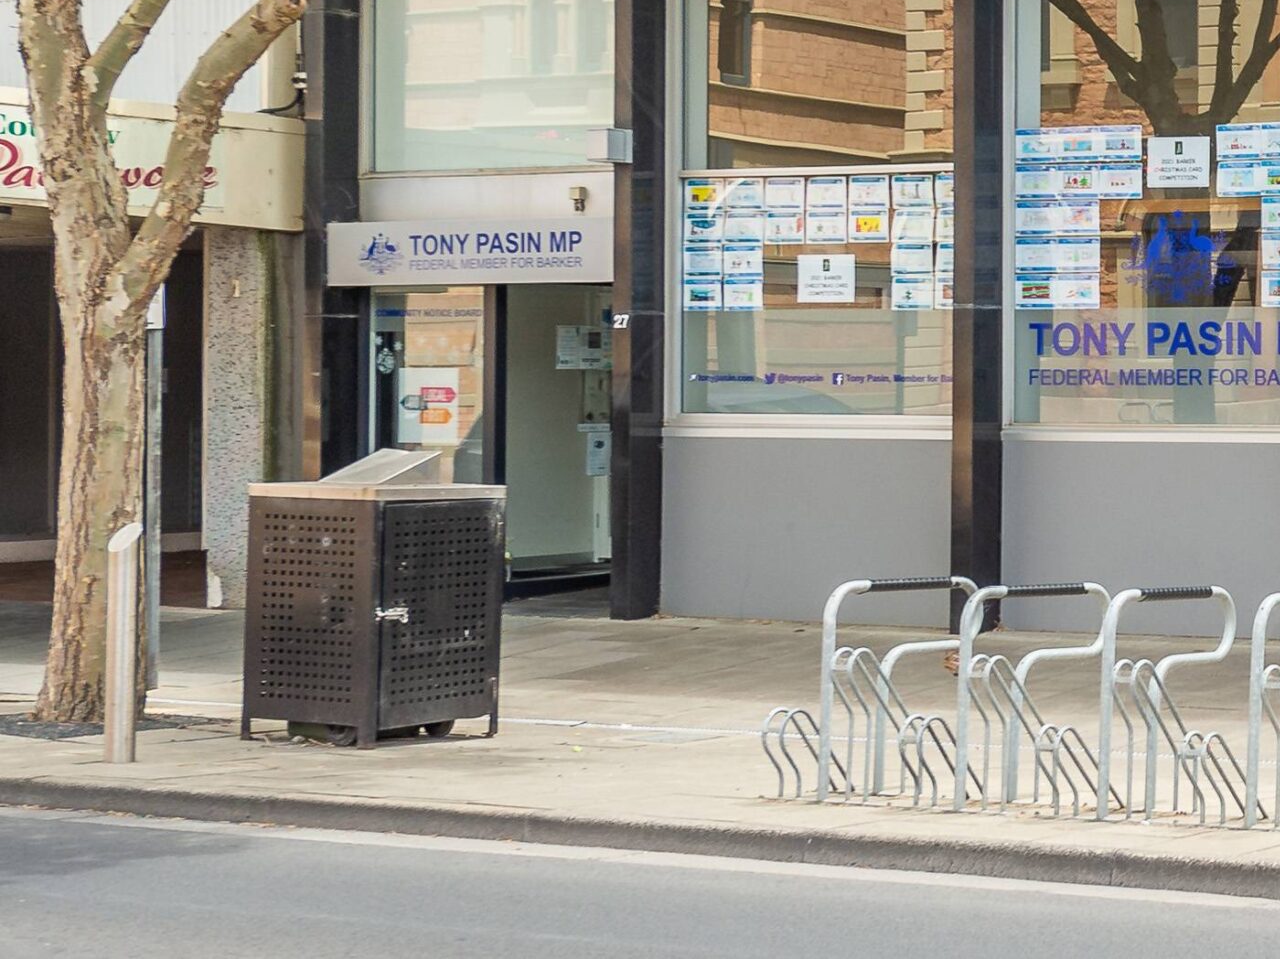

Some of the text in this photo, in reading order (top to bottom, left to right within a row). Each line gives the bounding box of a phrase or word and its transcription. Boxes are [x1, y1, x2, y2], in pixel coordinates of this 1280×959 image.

[408, 231, 583, 256] TONY PASIN MP
[409, 256, 583, 271] FEDERAL MEMBER FOR BARKER
[613, 314, 630, 329] 27
[1028, 321, 1136, 356] TONY
[1146, 321, 1262, 356] PASIN
[1028, 369, 1114, 386] FEDERAL
[1119, 369, 1203, 386] MEMBER
[1208, 369, 1248, 386] FOR
